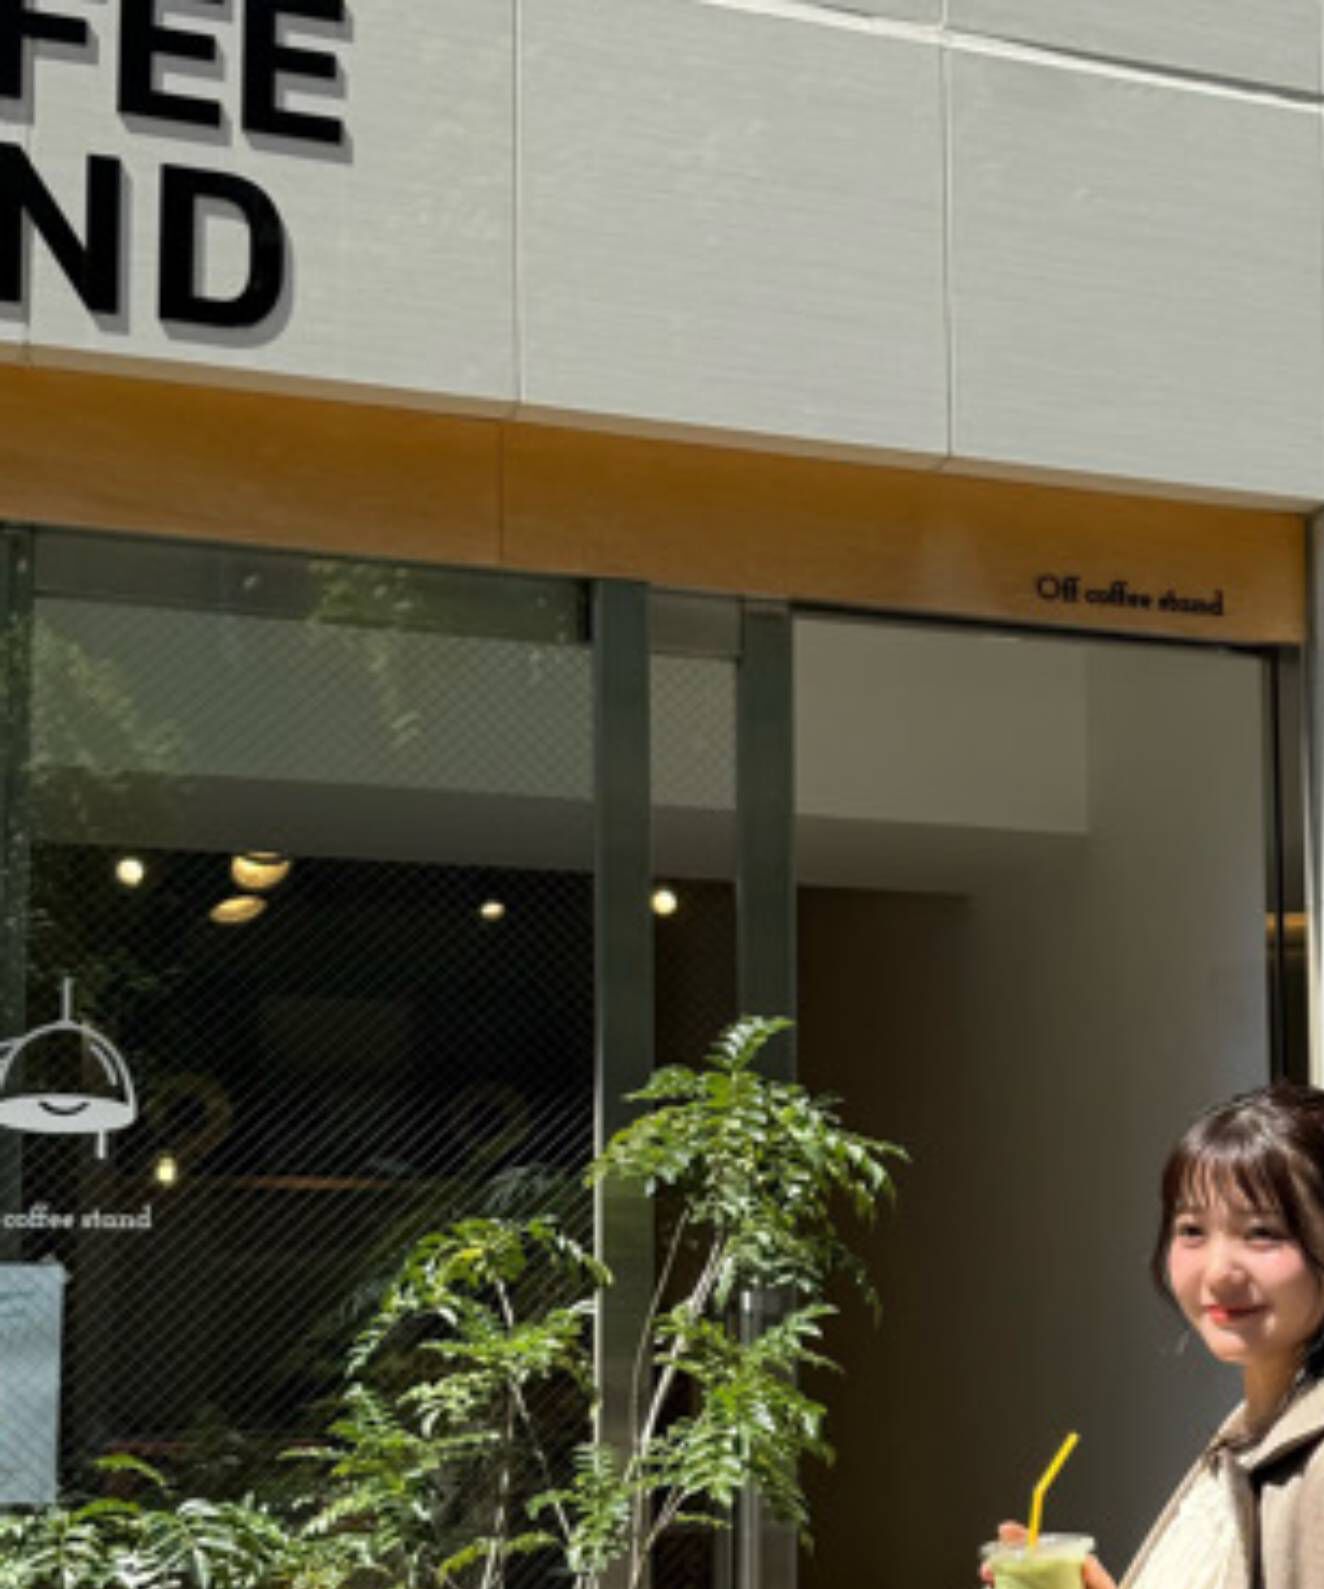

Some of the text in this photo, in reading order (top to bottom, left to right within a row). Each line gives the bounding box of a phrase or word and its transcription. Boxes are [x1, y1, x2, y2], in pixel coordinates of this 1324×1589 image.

[0, 140, 287, 330] ND
[1036, 574, 1225, 616] Off coffee stand
[3, 1203, 152, 1229] coffee stand
